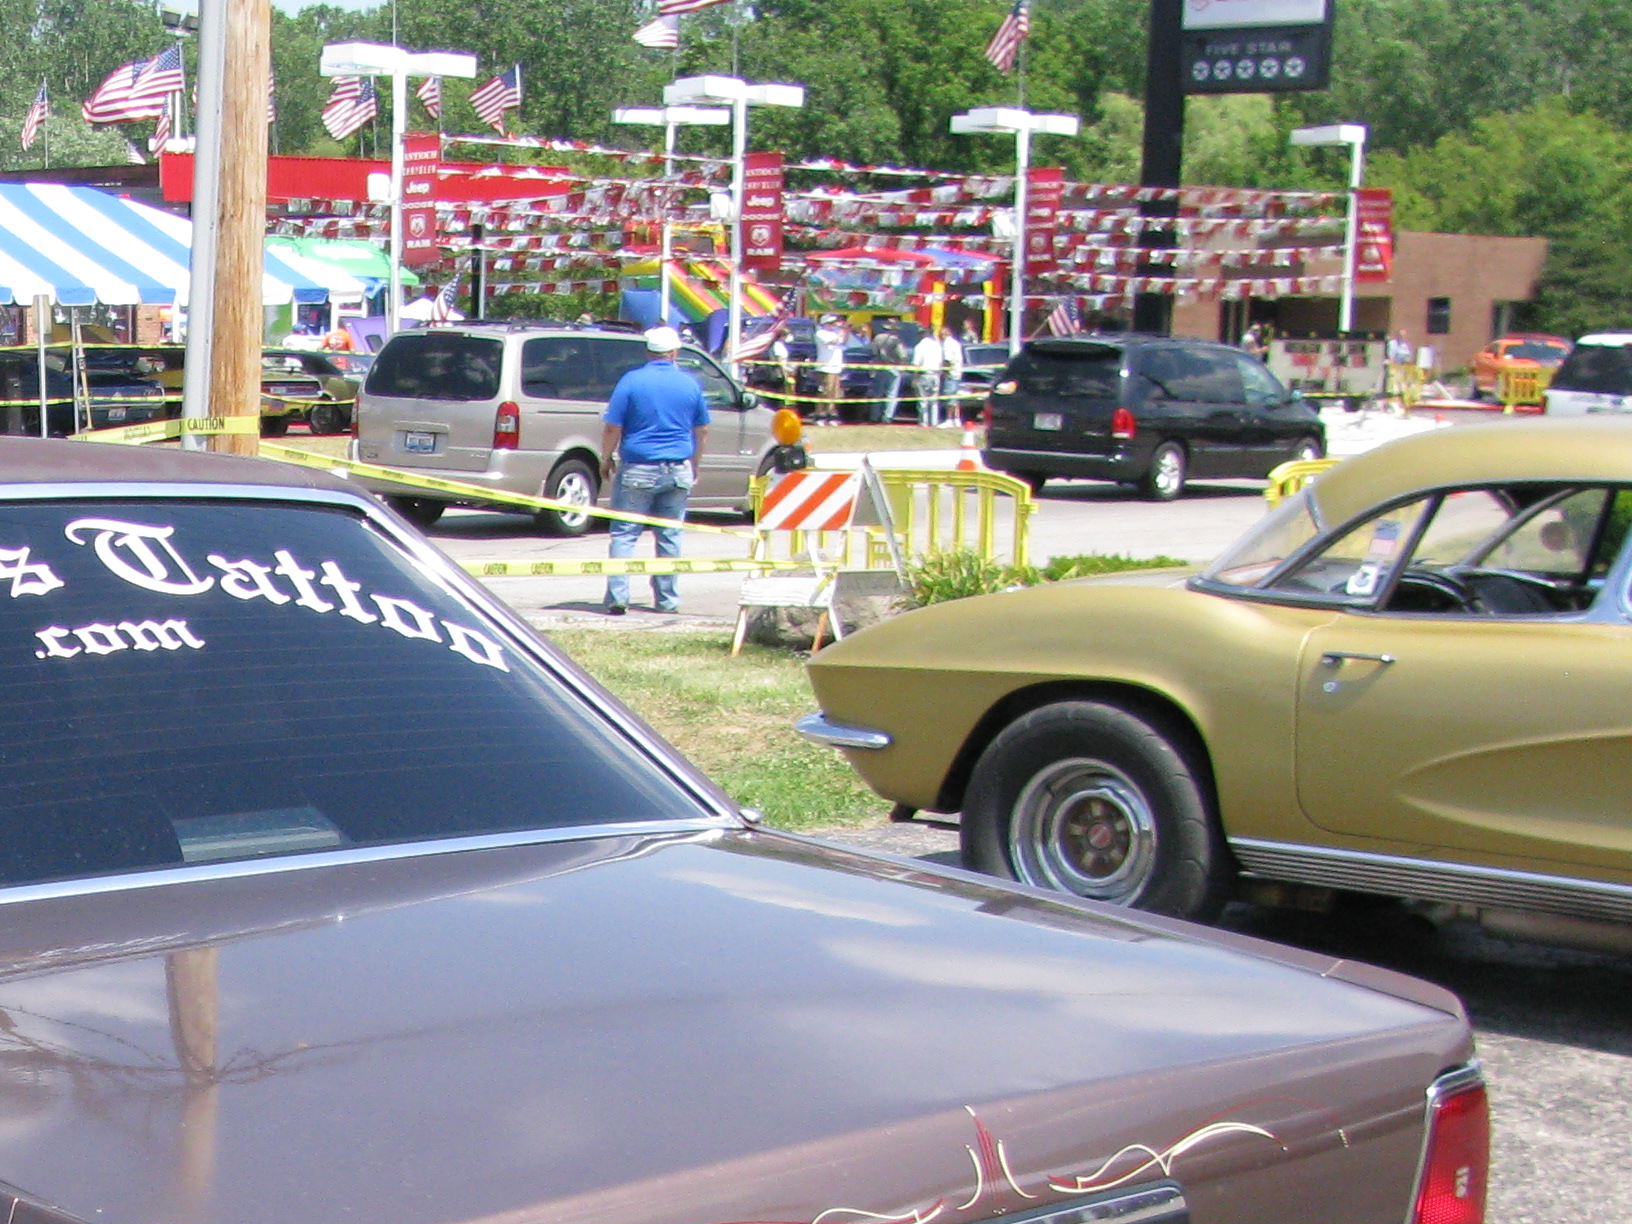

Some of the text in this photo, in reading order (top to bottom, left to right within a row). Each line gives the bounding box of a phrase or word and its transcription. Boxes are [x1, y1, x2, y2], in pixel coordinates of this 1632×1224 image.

[405, 181, 431, 194] Jeep
[406, 239, 432, 249] RAM
[187, 417, 225, 431] CAUTION
[64, 517, 511, 673] Tattoo
[34, 617, 206, 659] .com
